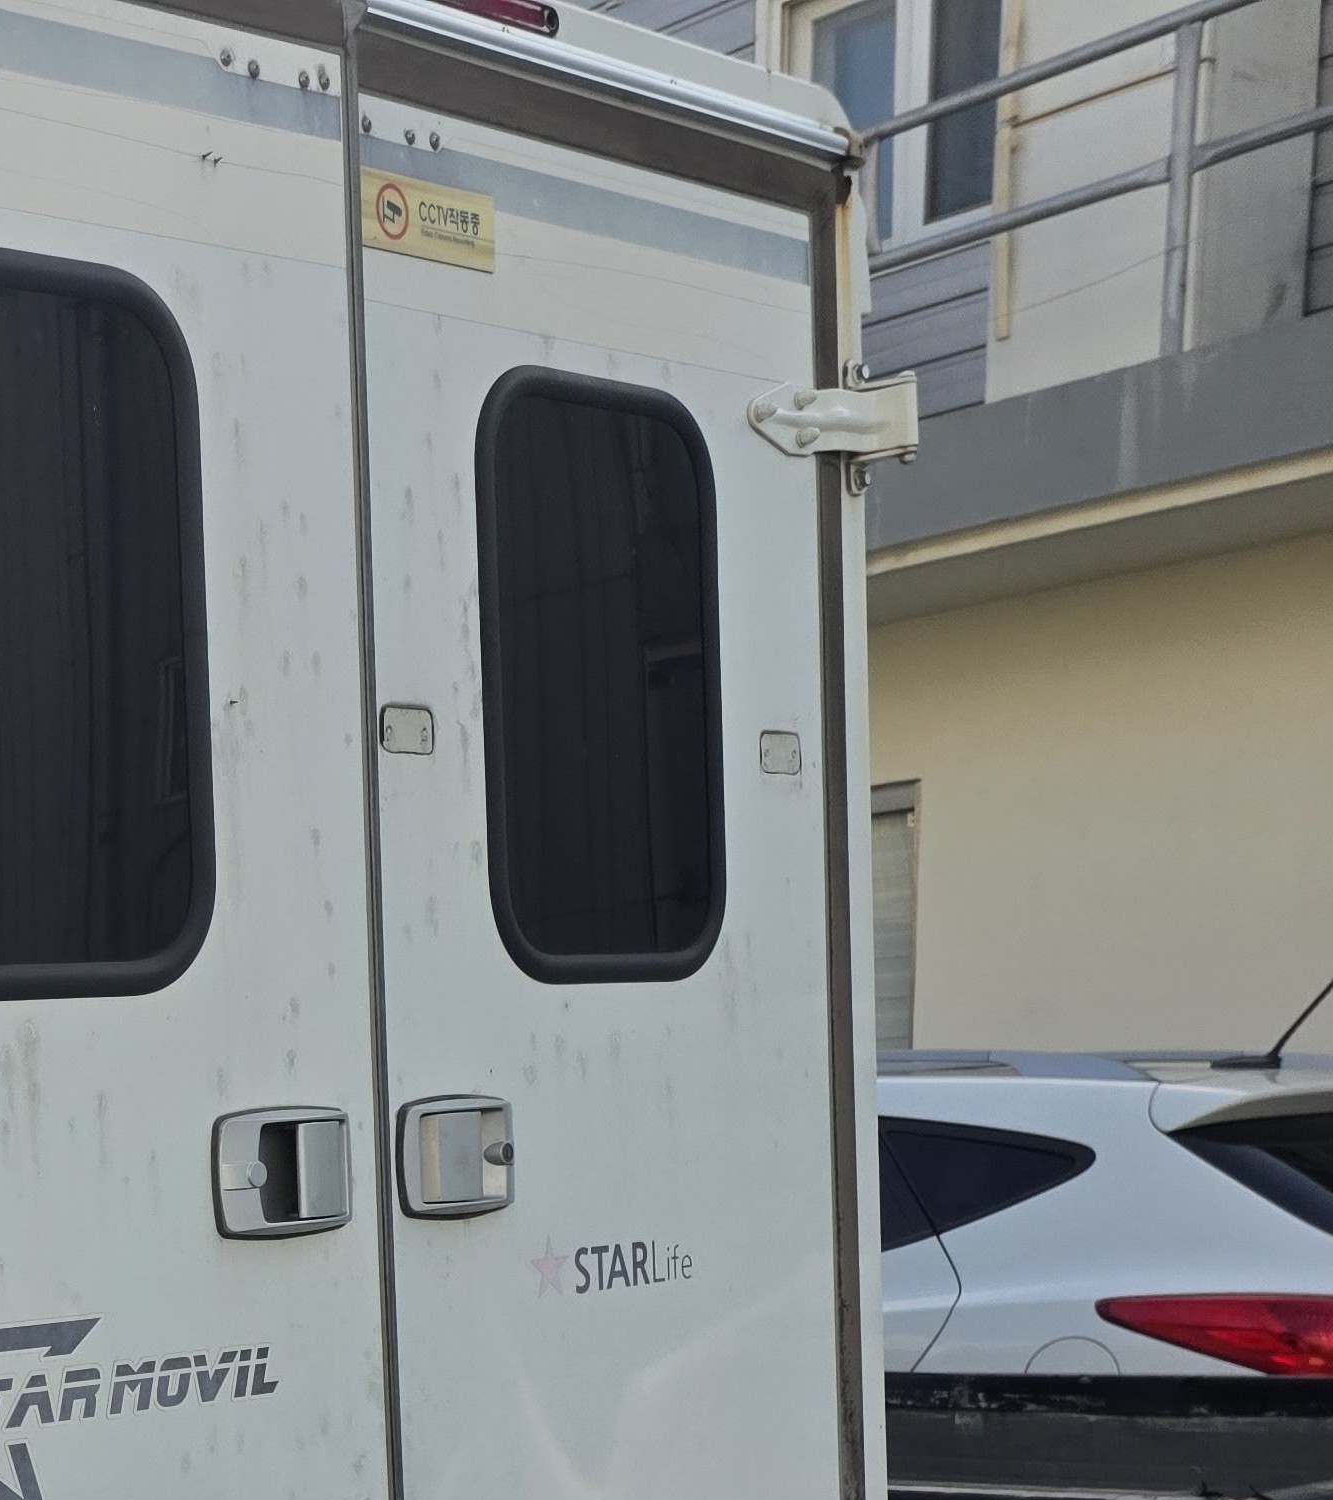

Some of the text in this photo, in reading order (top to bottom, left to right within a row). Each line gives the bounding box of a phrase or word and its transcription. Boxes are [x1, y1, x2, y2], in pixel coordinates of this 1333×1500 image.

[418, 200, 480, 236] CCTV작동중
[574, 1239, 693, 1295] STARLife
[108, 1346, 280, 1415] MOVIL
